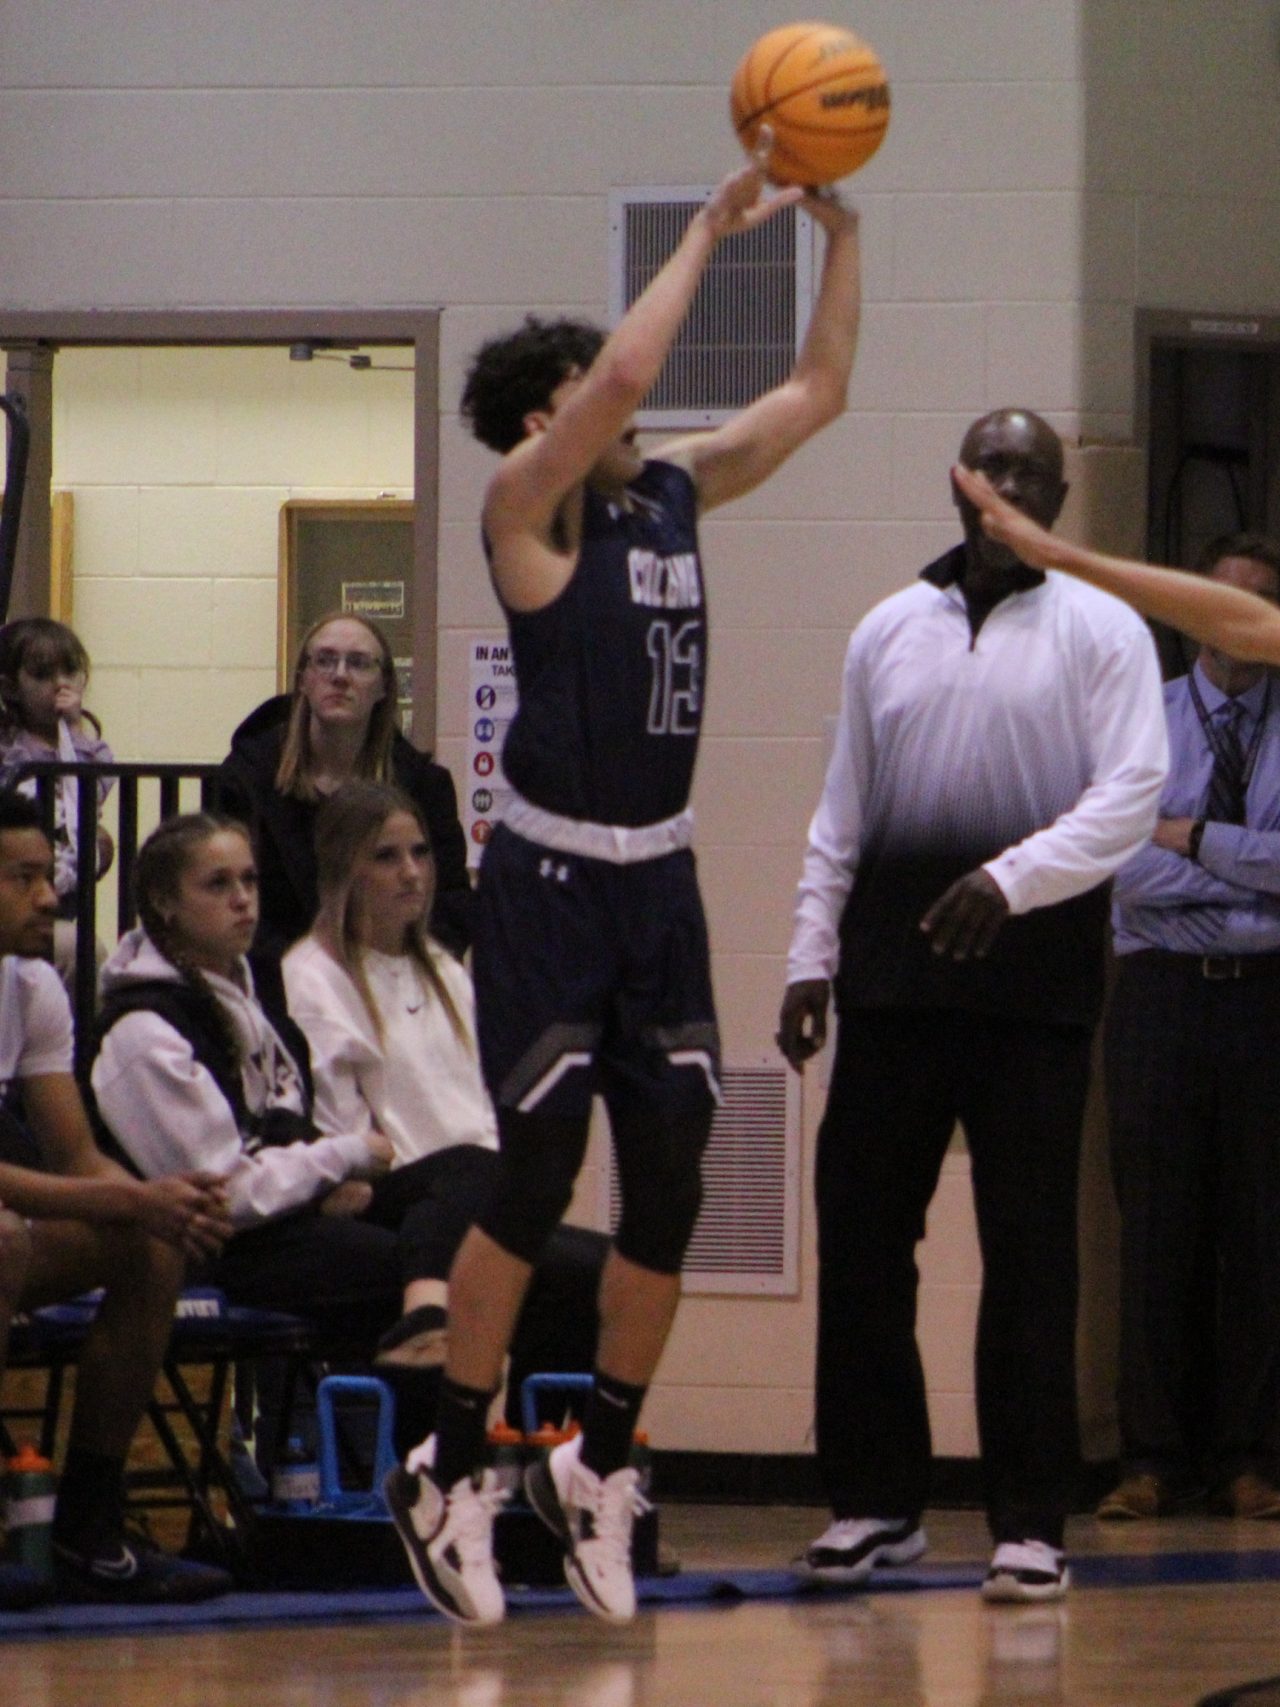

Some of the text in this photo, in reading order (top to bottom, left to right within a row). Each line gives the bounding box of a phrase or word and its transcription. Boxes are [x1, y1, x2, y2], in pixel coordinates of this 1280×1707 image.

[476, 645, 508, 661] IN AN
[491, 664, 516, 677] TAK
